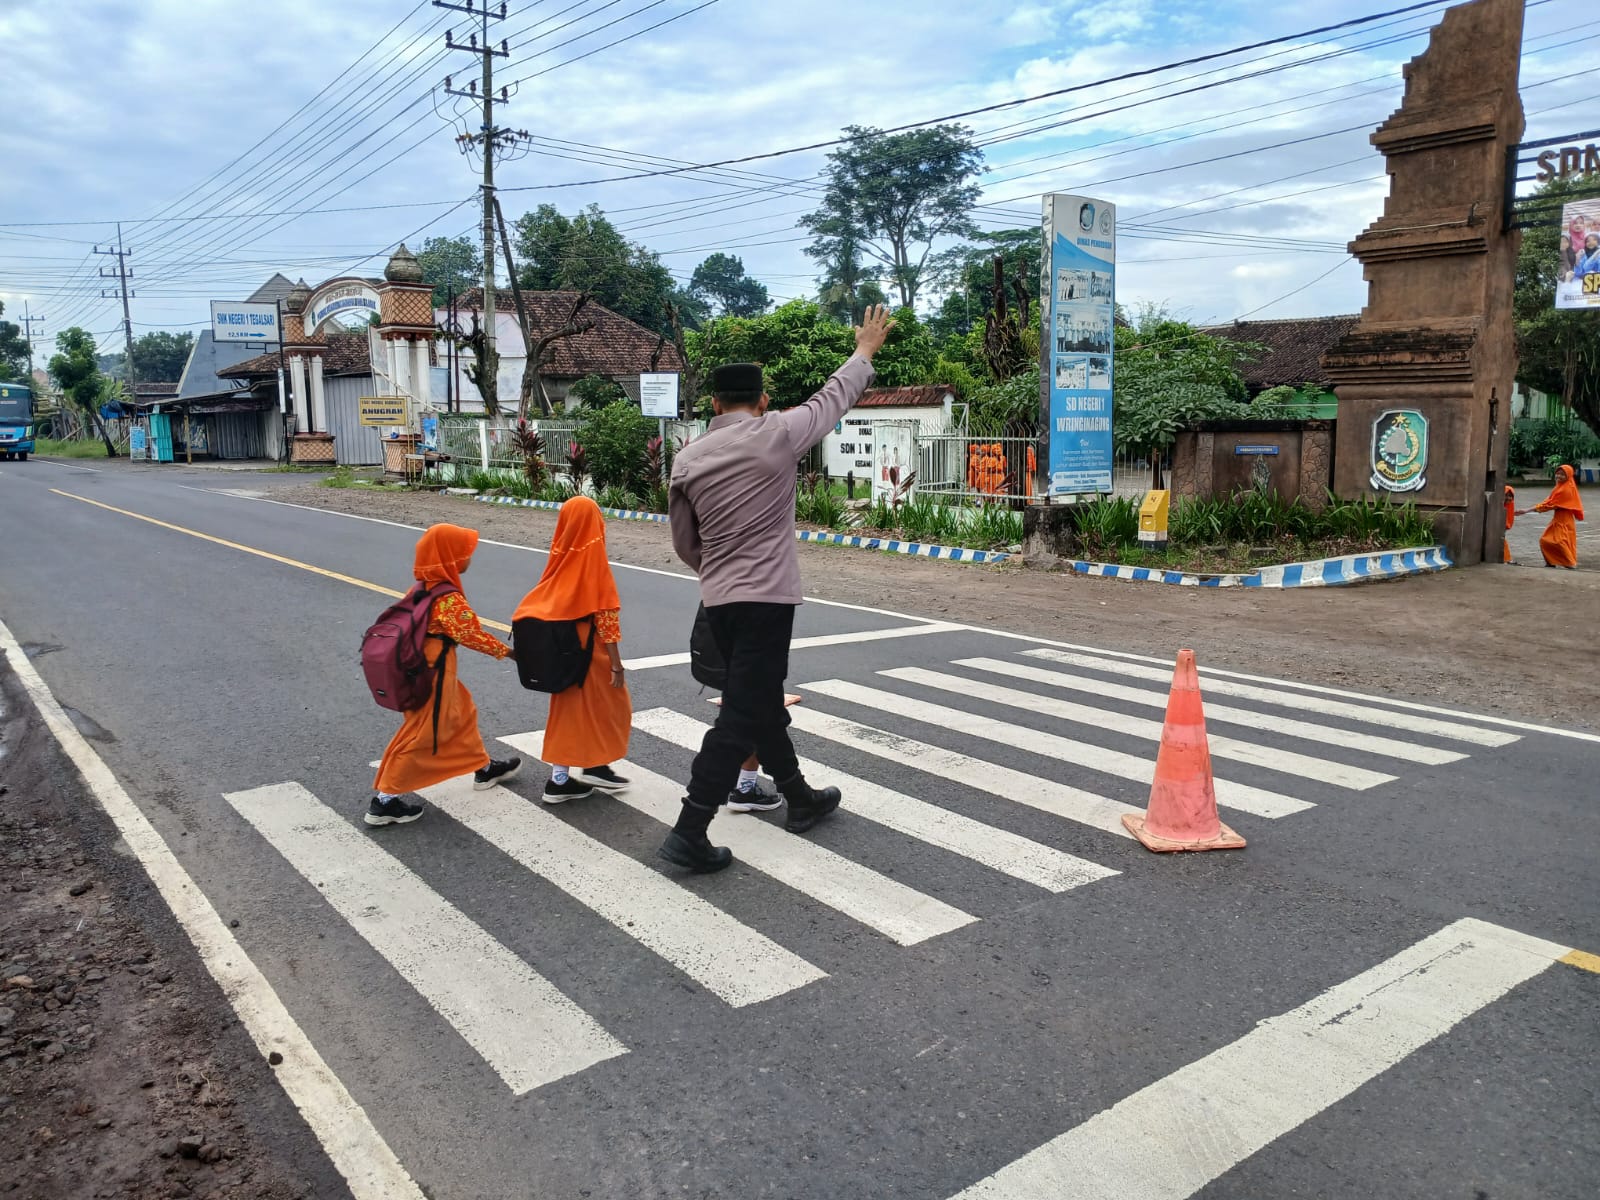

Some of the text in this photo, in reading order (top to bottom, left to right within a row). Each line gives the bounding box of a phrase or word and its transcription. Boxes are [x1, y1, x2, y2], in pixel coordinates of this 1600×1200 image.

[228, 313, 245, 325] NEGERI
[1066, 396, 1077, 411] SD
[1078, 396, 1100, 411] NEGERI
[840, 443, 856, 454] SDN
